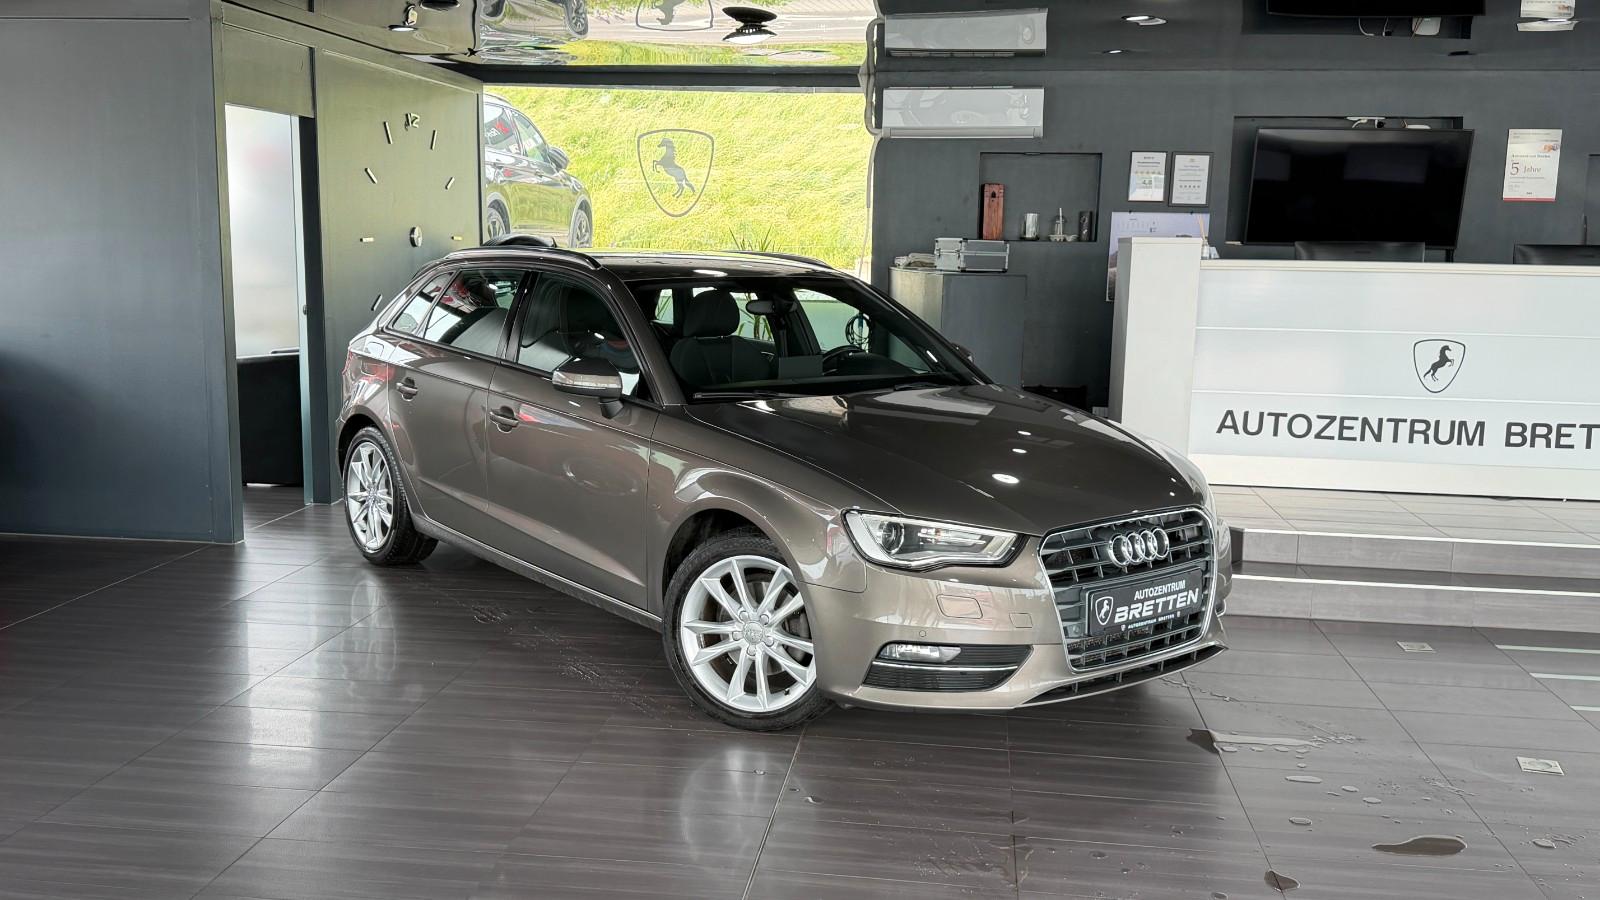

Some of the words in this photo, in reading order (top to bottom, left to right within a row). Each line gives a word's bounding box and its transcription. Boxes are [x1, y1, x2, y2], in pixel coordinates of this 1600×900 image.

[1510, 162, 1520, 176] 5
[1216, 409, 1485, 447] AUTOZENTRUM
[1504, 422, 1600, 450] BRET
[1134, 579, 1186, 600] AUTOZENTRUM
[1114, 588, 1199, 623] BRETTEN
